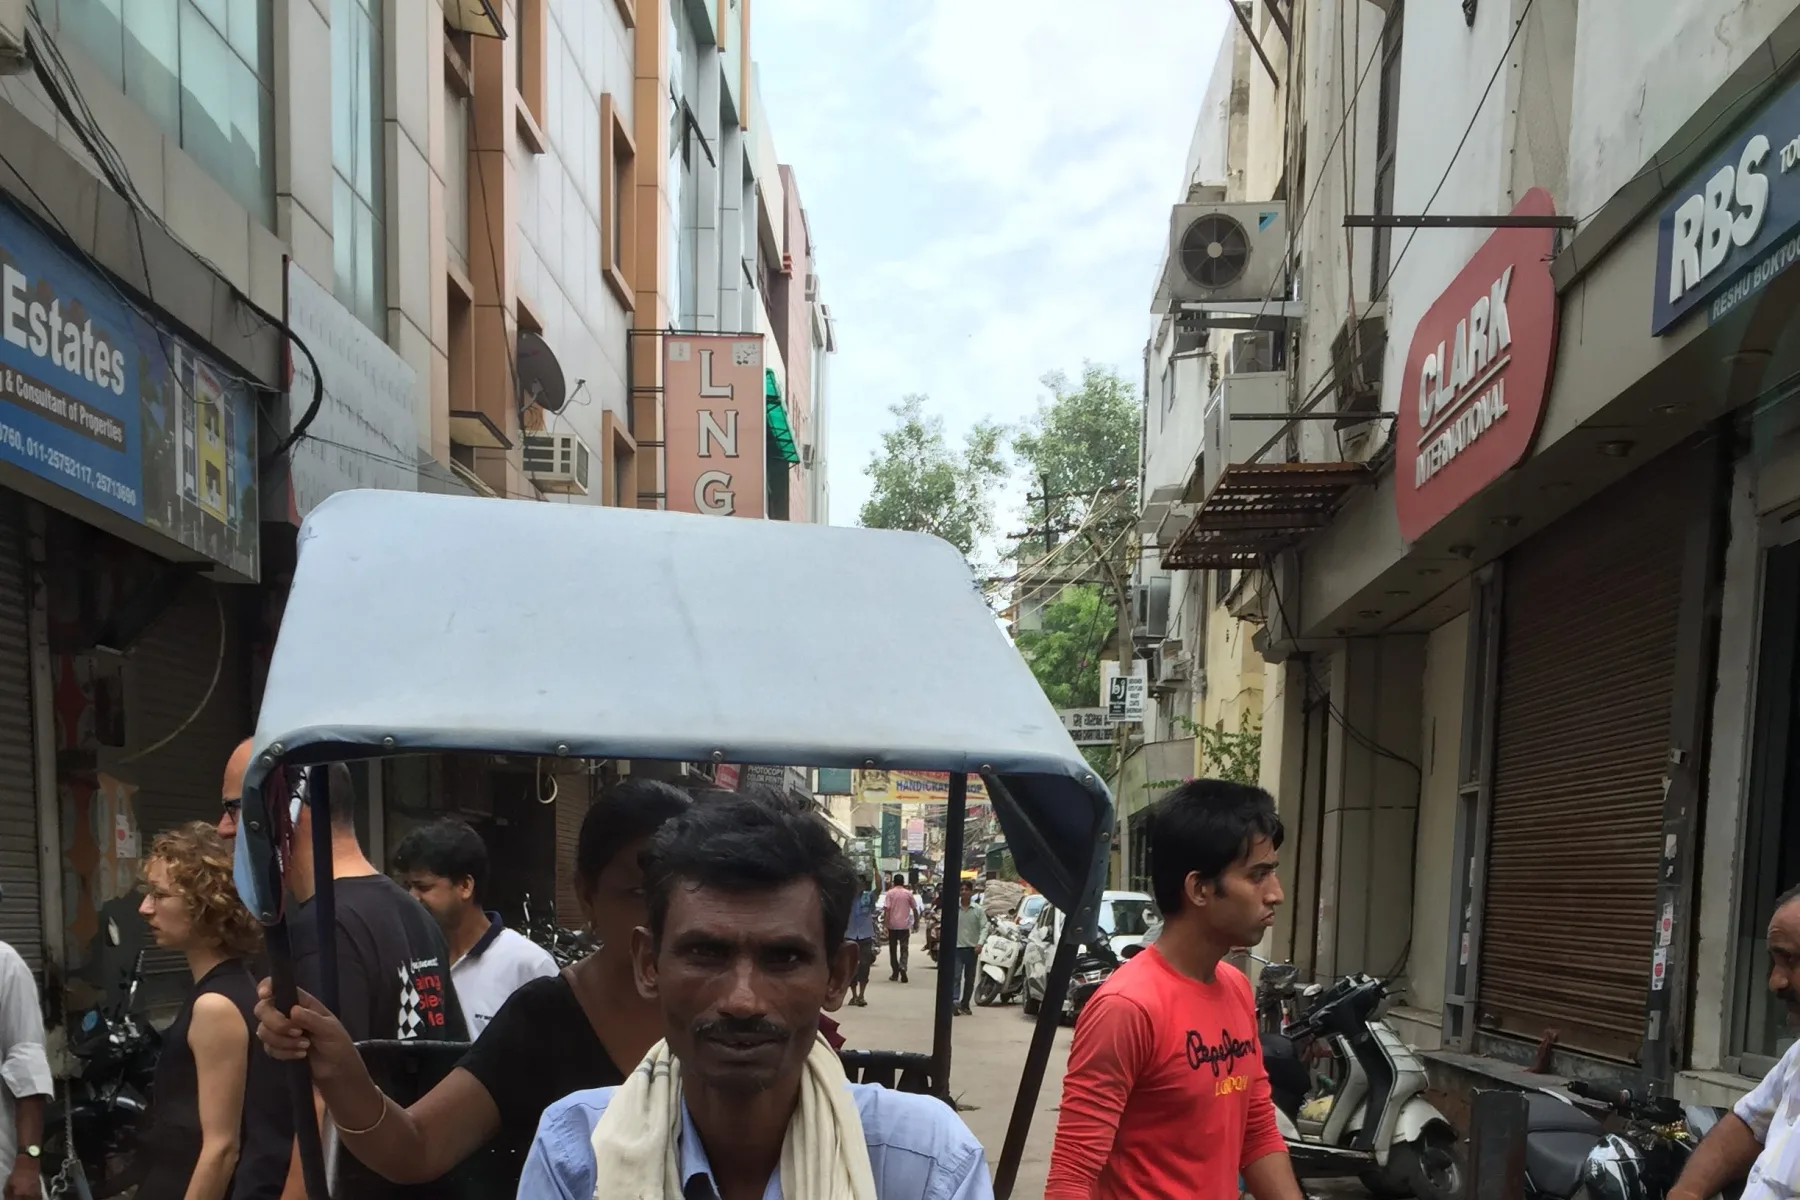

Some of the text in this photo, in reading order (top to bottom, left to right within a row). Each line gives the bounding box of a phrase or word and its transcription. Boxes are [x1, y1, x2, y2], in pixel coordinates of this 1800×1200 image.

[1669, 134, 1770, 304] RBS
[2, 262, 125, 396] Estates
[1419, 264, 1514, 429] CLARK
[1713, 272, 1750, 320] RESHU
[5, 369, 13, 392] &
[16, 374, 67, 418] Consultant
[68, 402, 78, 421] of
[80, 405, 122, 443] Properties
[1415, 377, 1508, 489] INTERNATIONAL
[747, 764, 784, 776] PHOTOCOPY
